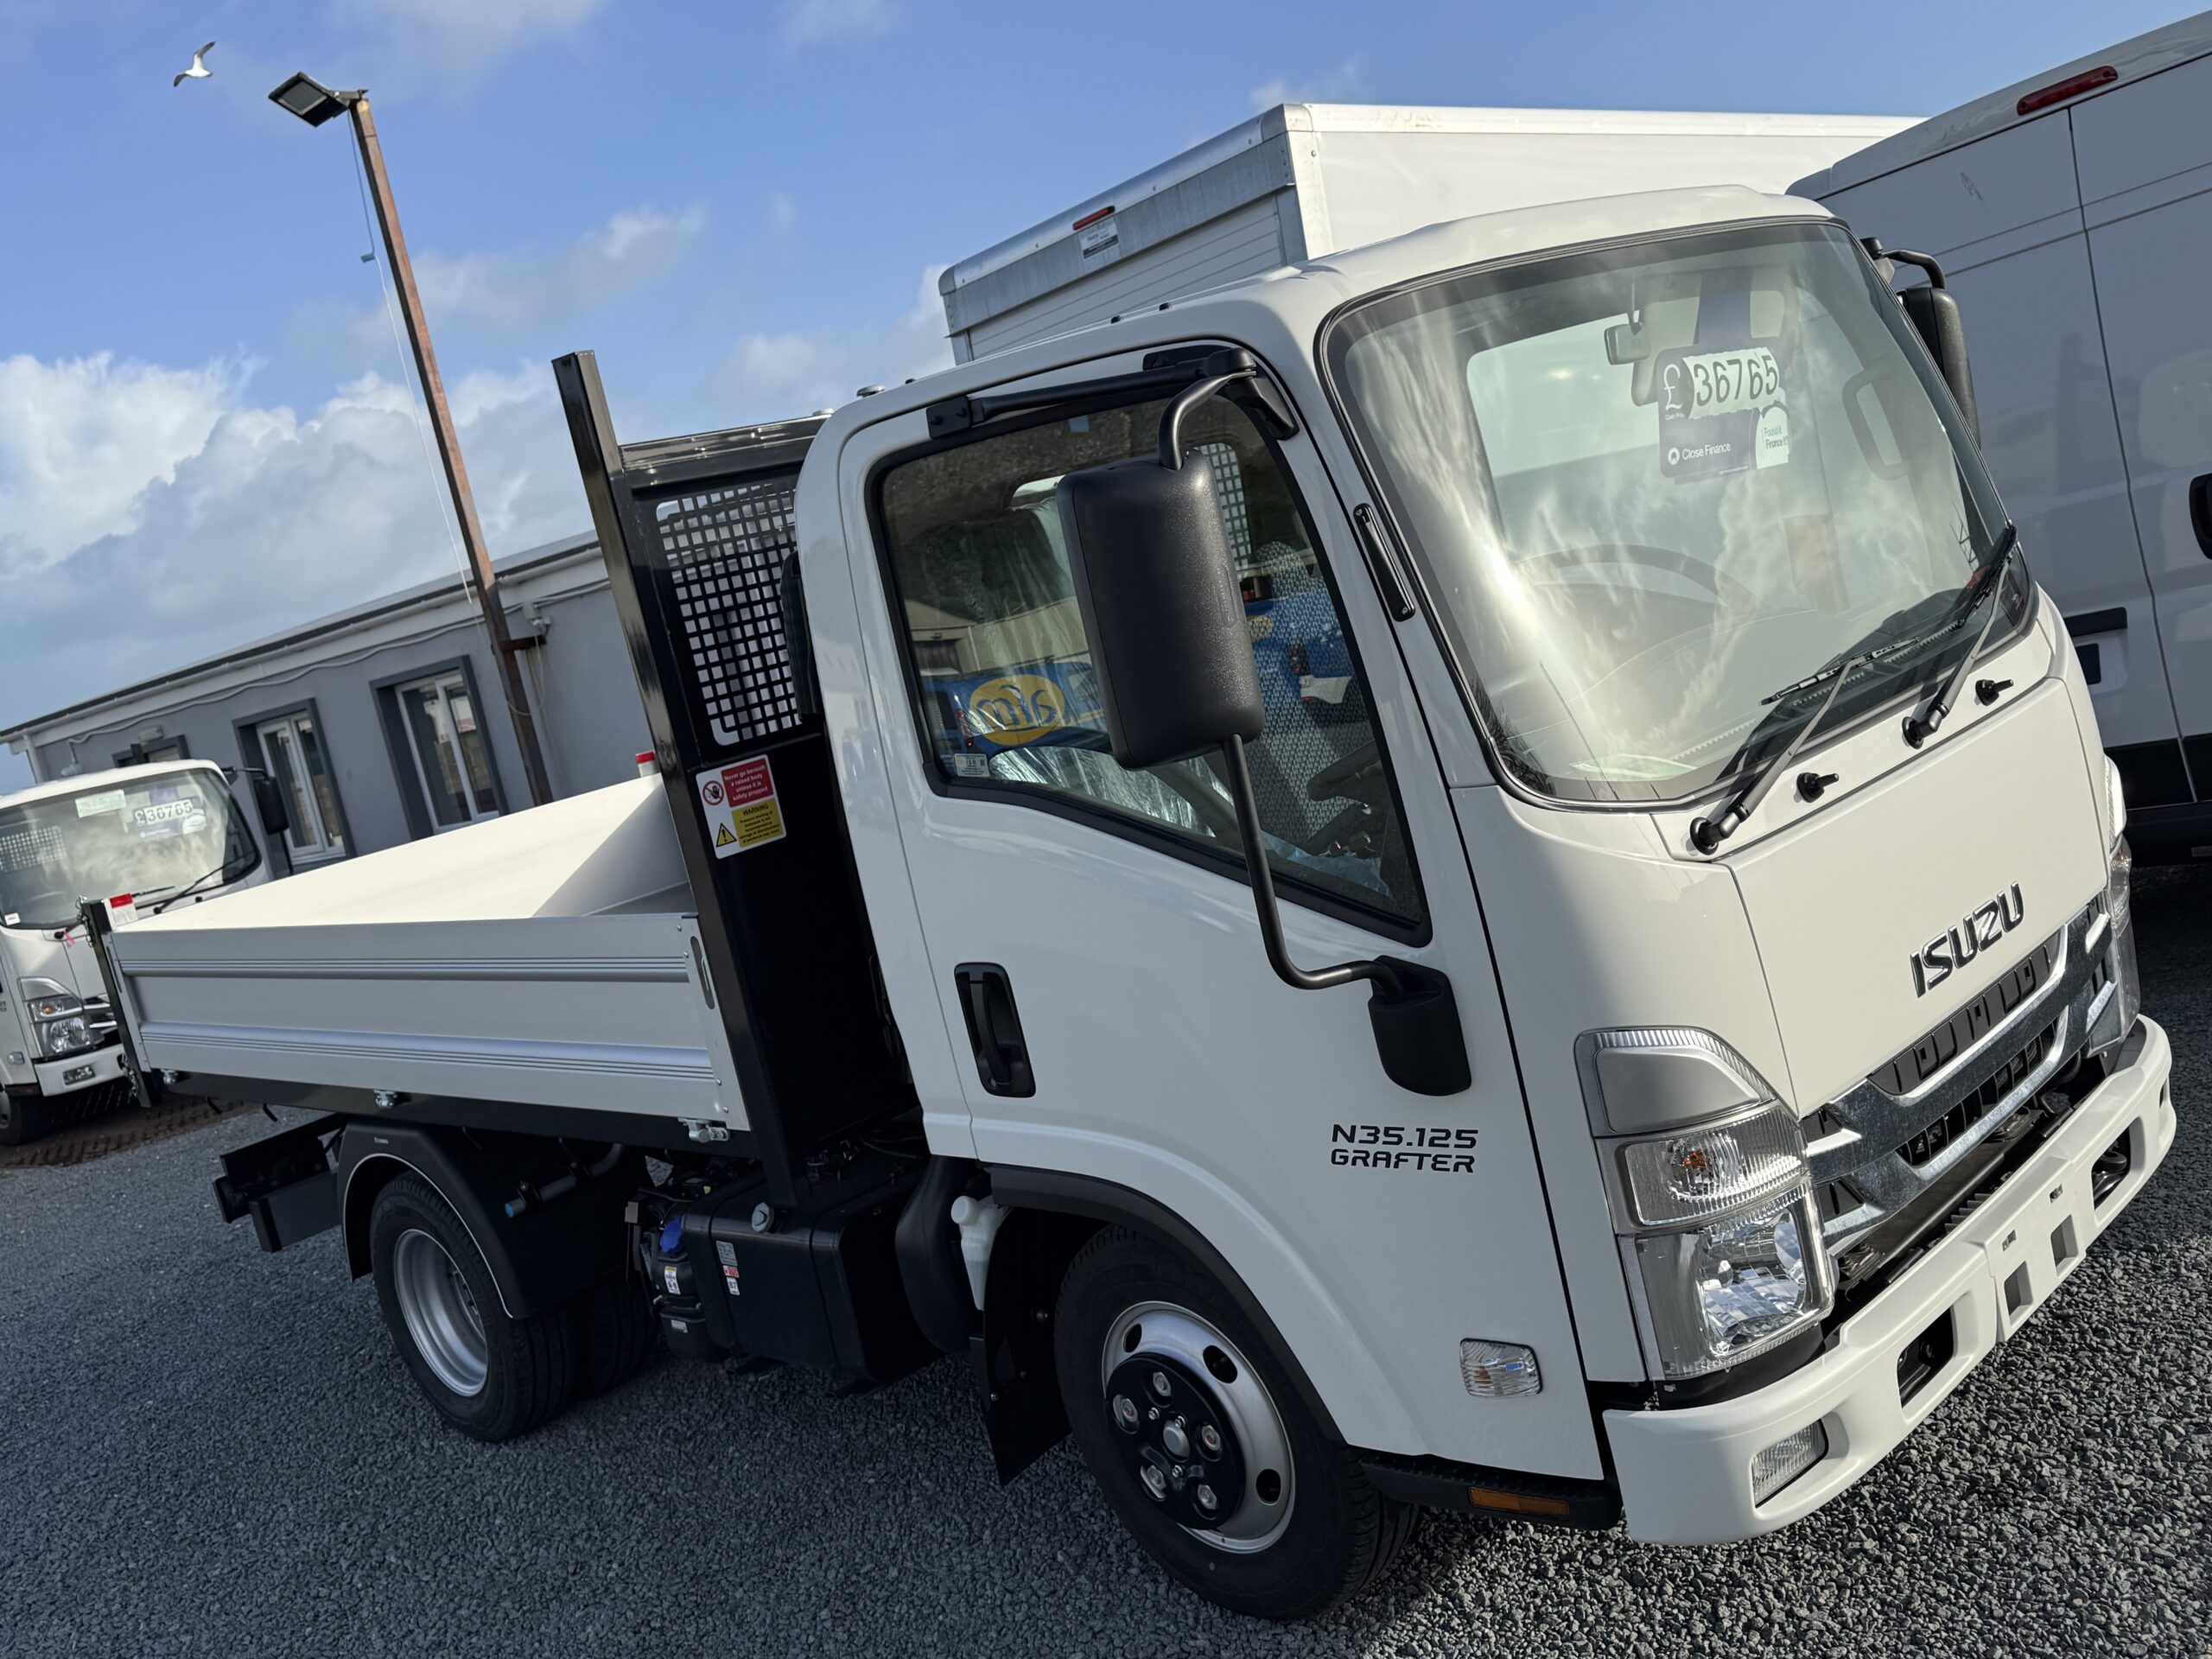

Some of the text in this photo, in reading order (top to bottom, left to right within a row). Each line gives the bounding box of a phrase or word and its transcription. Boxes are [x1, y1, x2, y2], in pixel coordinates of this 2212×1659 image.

[1663, 354, 1778, 411] £ 36765
[1681, 442, 1732, 461] Close Finance
[147, 801, 194, 822] 36765
[742, 803, 769, 816] WARNING
[1910, 880, 2024, 998] ISUZU
[1332, 1123, 1478, 1149] N35.125
[1331, 1148, 1475, 1173] GRAFTER
